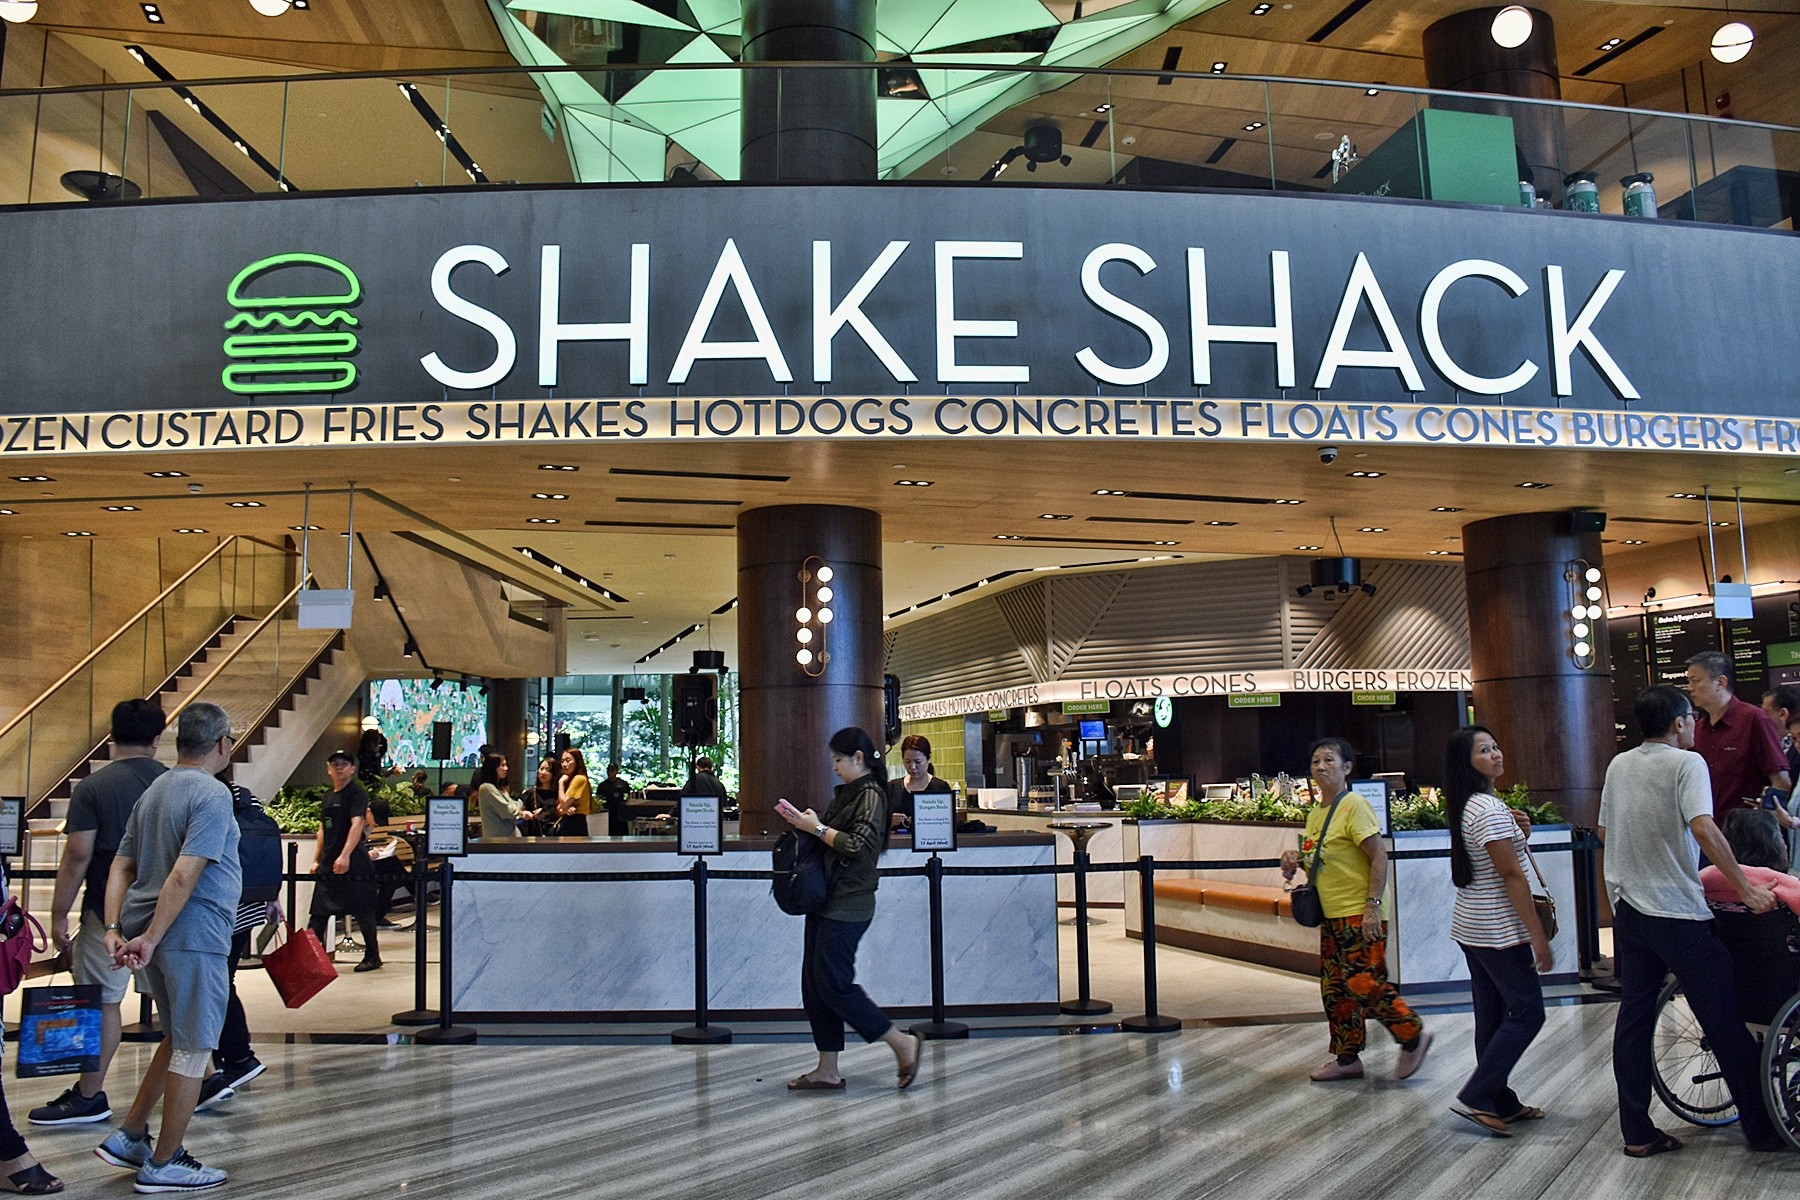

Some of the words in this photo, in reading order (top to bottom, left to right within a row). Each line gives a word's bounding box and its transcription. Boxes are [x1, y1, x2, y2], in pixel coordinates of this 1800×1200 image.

[420, 238, 1030, 389] SHAKE
[1075, 243, 1641, 399] SHACK
[0, 415, 90, 451] ZEN
[101, 409, 304, 449] CUSTARD
[324, 405, 444, 442] FRIES
[466, 400, 648, 440] SHAKES
[671, 398, 913, 436] HOTDOGS
[934, 398, 1222, 436] CONCRETES
[1241, 402, 1398, 440] FLOATS
[1415, 407, 1558, 445] CONES
[1573, 412, 1743, 450] BURGERS
[1754, 419, 1800, 452] FR
[1081, 677, 1162, 699] FLOATS
[1173, 673, 1256, 695] CONES
[1293, 671, 1388, 690] BURGERS
[905, 705, 921, 720] FRIES
[923, 701, 946, 718] SHAKES
[948, 694, 985, 714] HOTDOGS
[987, 685, 1038, 709] CONCRETES
